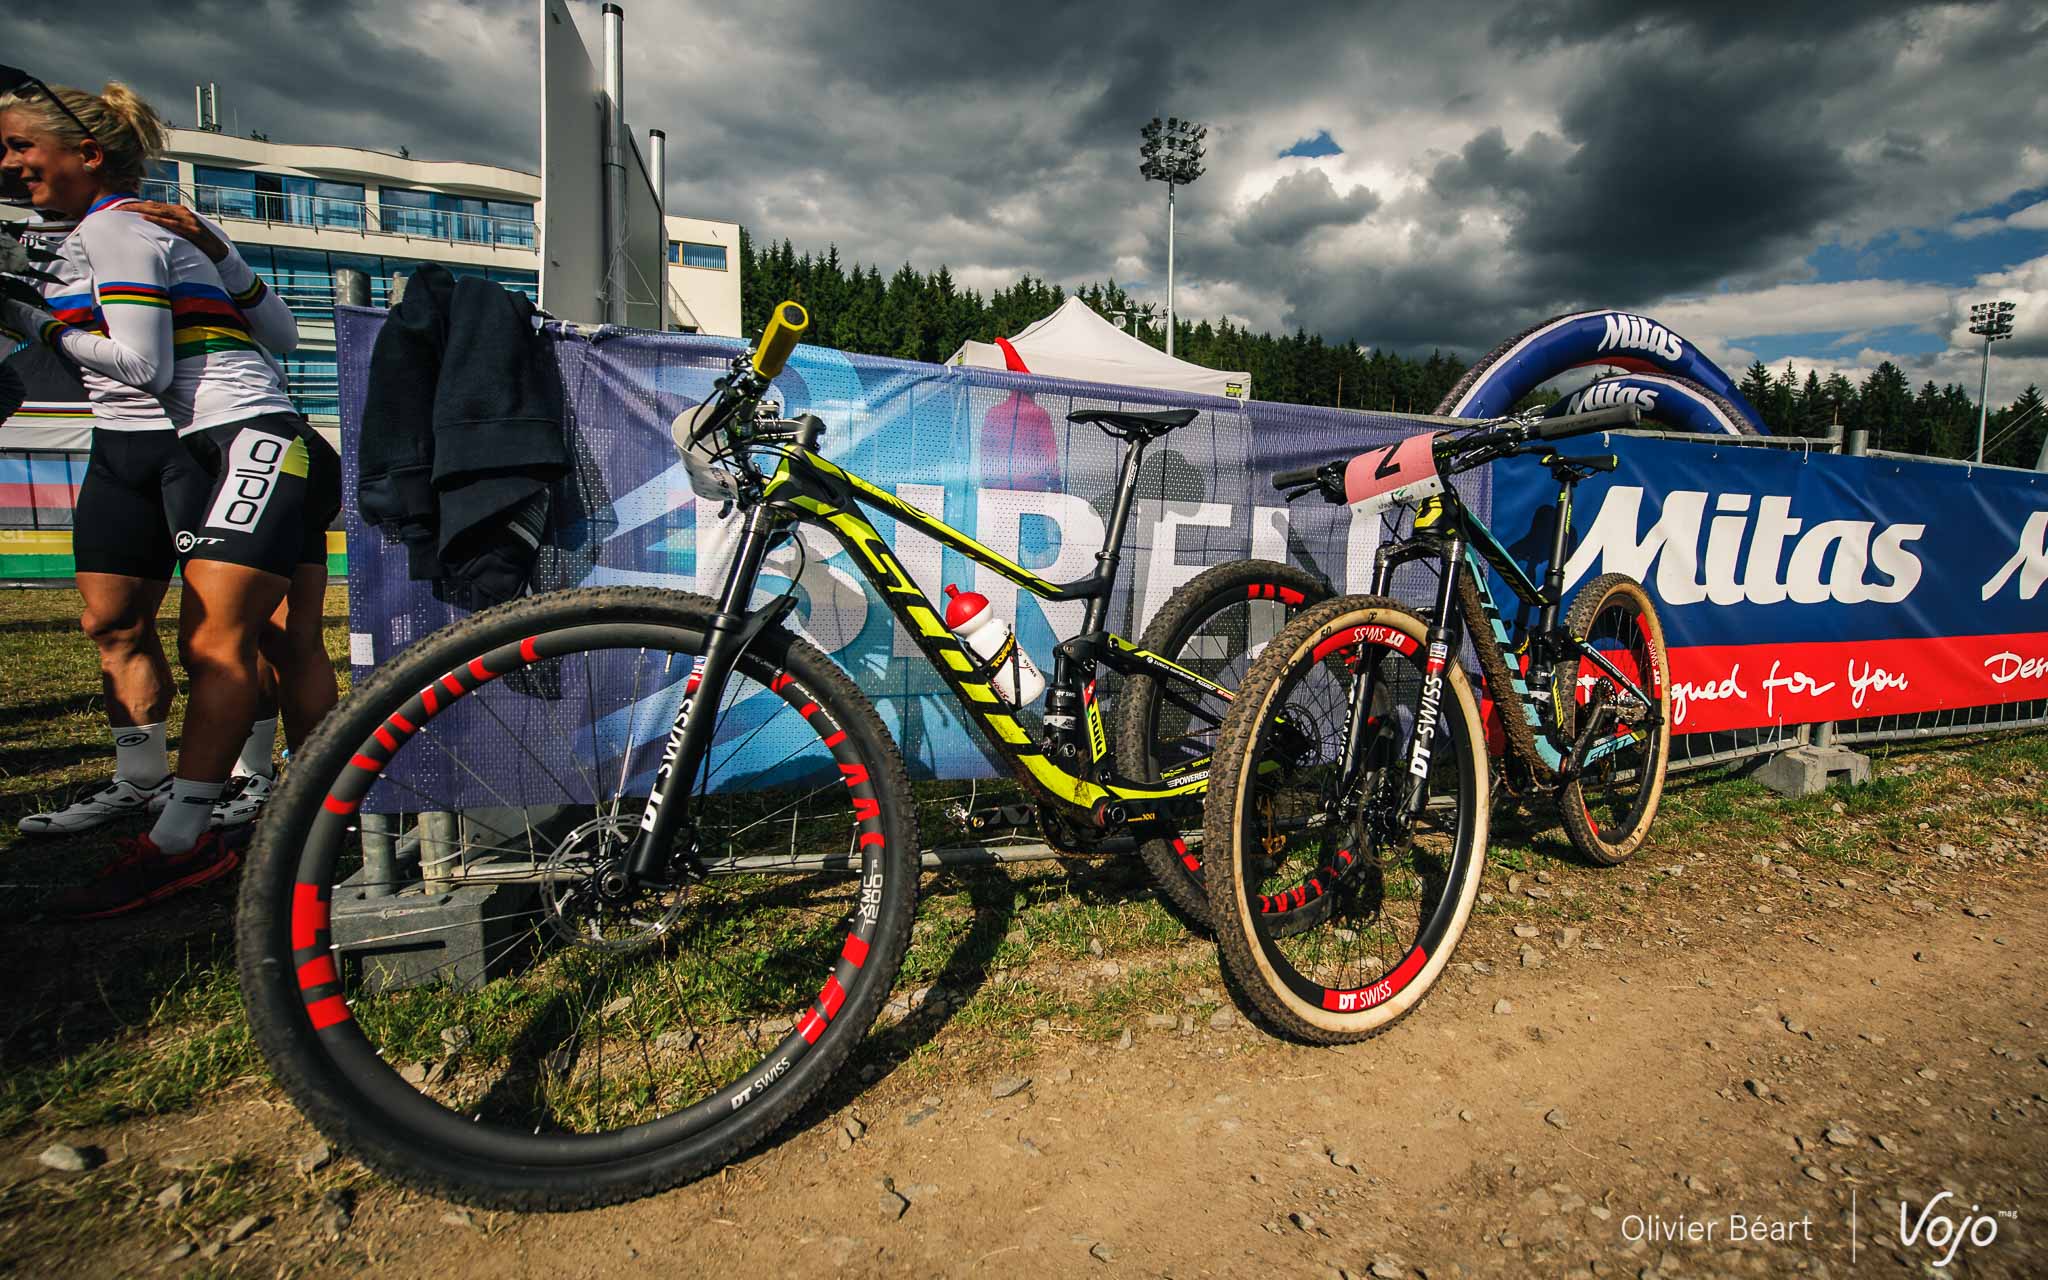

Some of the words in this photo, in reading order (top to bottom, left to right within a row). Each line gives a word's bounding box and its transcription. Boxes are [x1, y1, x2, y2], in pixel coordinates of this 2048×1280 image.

[1598, 314, 1683, 361] Mitas
[1565, 380, 1659, 416] Mitas
[224, 439, 283, 525] odlo
[1538, 486, 1926, 606] Mitas
[1352, 627, 1385, 643] SWISS
[1385, 631, 1405, 647] DT
[1647, 638, 1659, 667] SWISS
[1653, 668, 1661, 685] DT
[1762, 660, 1836, 718] for
[1848, 658, 1909, 708] You
[1417, 675, 1443, 739] SWISS
[641, 783, 664, 833] DT
[658, 698, 693, 779] SWISS
[1174, 769, 1210, 788] POWERED
[1409, 739, 1431, 779] DT
[857, 874, 873, 918] XMC
[865, 873, 884, 926] 1200
[1338, 993, 1358, 1010] DT
[1360, 980, 1392, 1008] SWISS
[731, 1086, 753, 1111] DT
[754, 1056, 791, 1093] SWISS
